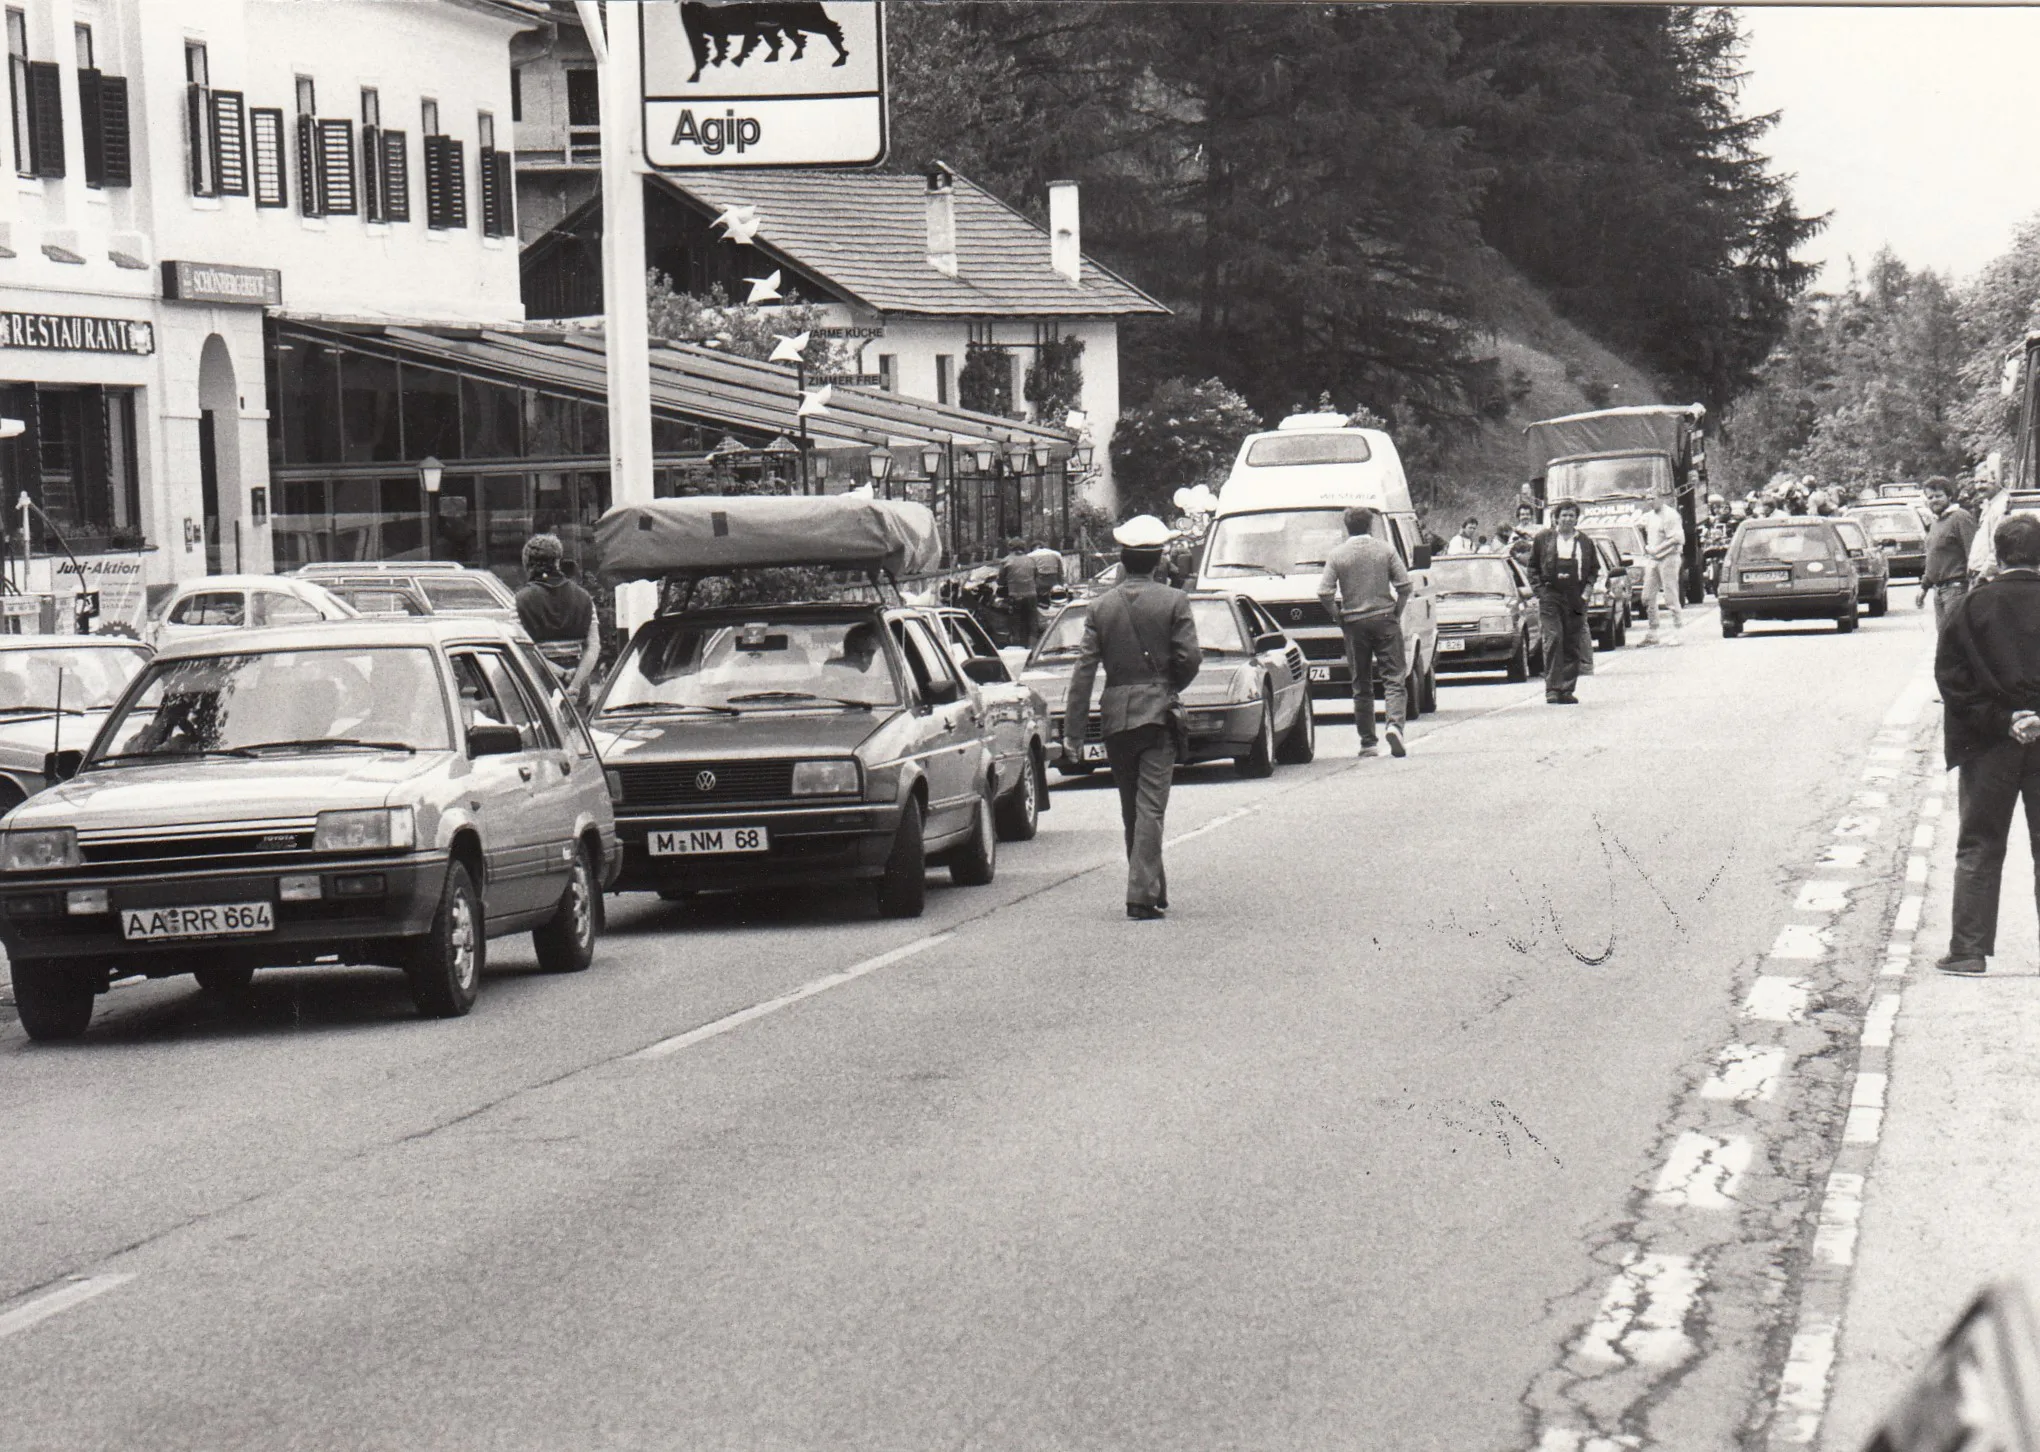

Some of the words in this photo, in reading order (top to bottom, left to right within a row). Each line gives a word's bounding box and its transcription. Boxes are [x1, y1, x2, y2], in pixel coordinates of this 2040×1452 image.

[671, 109, 761, 155] Agip
[12, 314, 127, 350] RESTAURANT
[846, 326, 884, 338] KÜCHE
[808, 376, 852, 387] ZIMMER
[856, 375, 882, 386] FREI
[57, 560, 141, 575] Juni-Aktion
[1311, 669, 1326, 680] 74
[263, 834, 296, 842] TOYOTA
[735, 829, 759, 849] 68
[224, 904, 270, 929] 664
